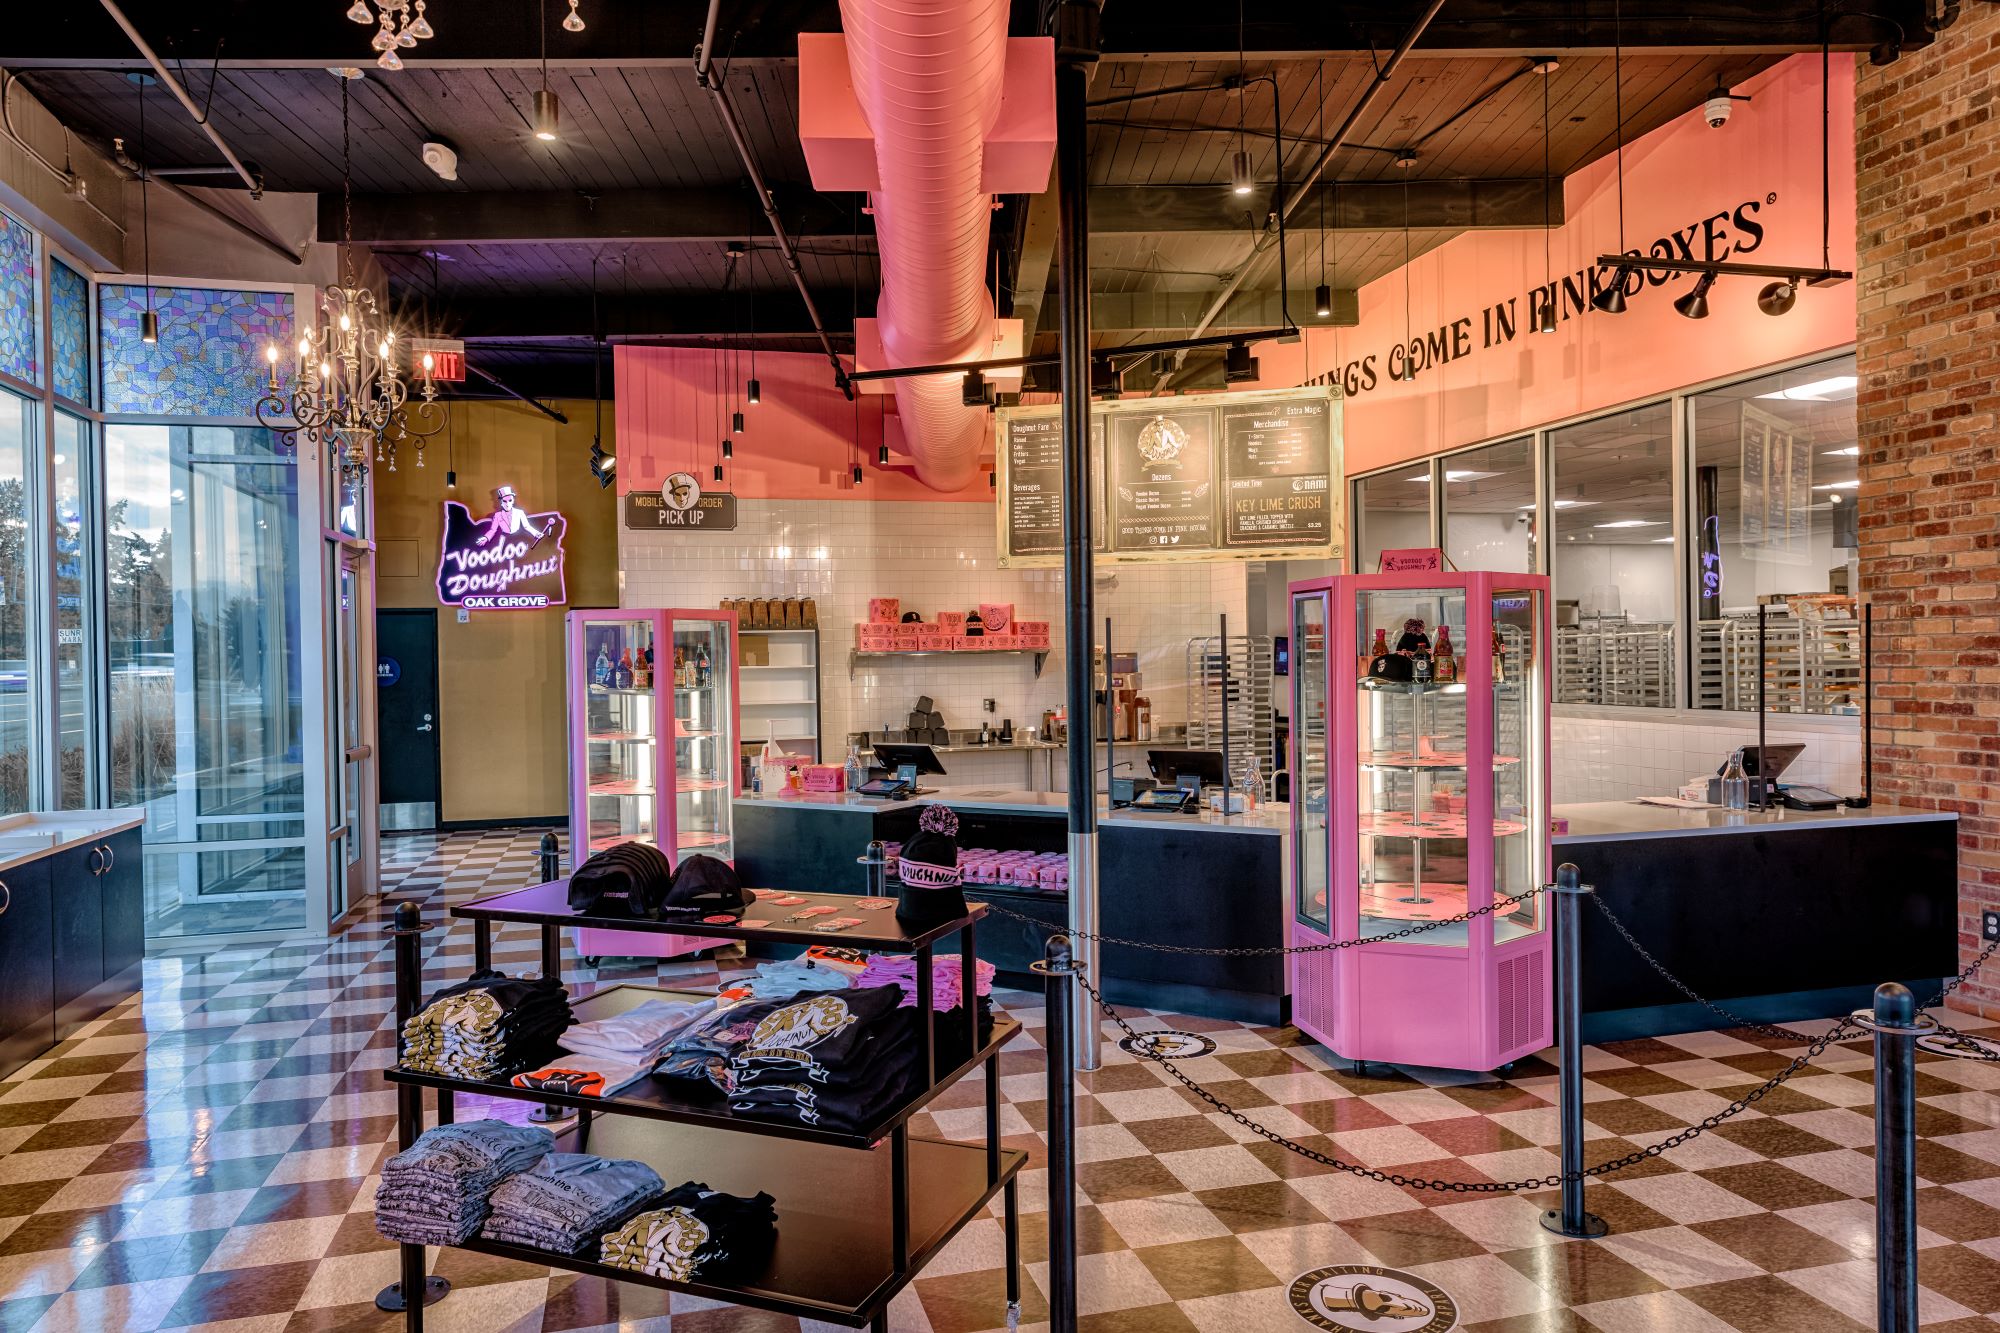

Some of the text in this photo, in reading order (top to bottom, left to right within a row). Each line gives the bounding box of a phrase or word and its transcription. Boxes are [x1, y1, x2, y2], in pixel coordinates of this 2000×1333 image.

[1388, 318, 1472, 381] COME
[1483, 297, 1516, 349] IN
[1528, 265, 1609, 333] PINK
[1286, 406, 1321, 415] Extra Magic
[1037, 423, 1049, 431] Fare
[1253, 419, 1289, 428] Merchandise
[1151, 473, 1172, 481] Dozens
[1013, 484, 1041, 492] Beverages
[635, 496, 723, 508] MOBILE ORDER
[1235, 496, 1321, 513] KEY LIME CRUSH
[659, 510, 704, 525] PICK UP
[446, 536, 529, 572] Voodoo
[446, 554, 559, 596] Doughnut
[464, 596, 547, 607] OAK GROVE
[553, 1178, 572, 1192] the
[1292, 1281, 1311, 1299] FOR
[1306, 1266, 1384, 1281] WAITING
